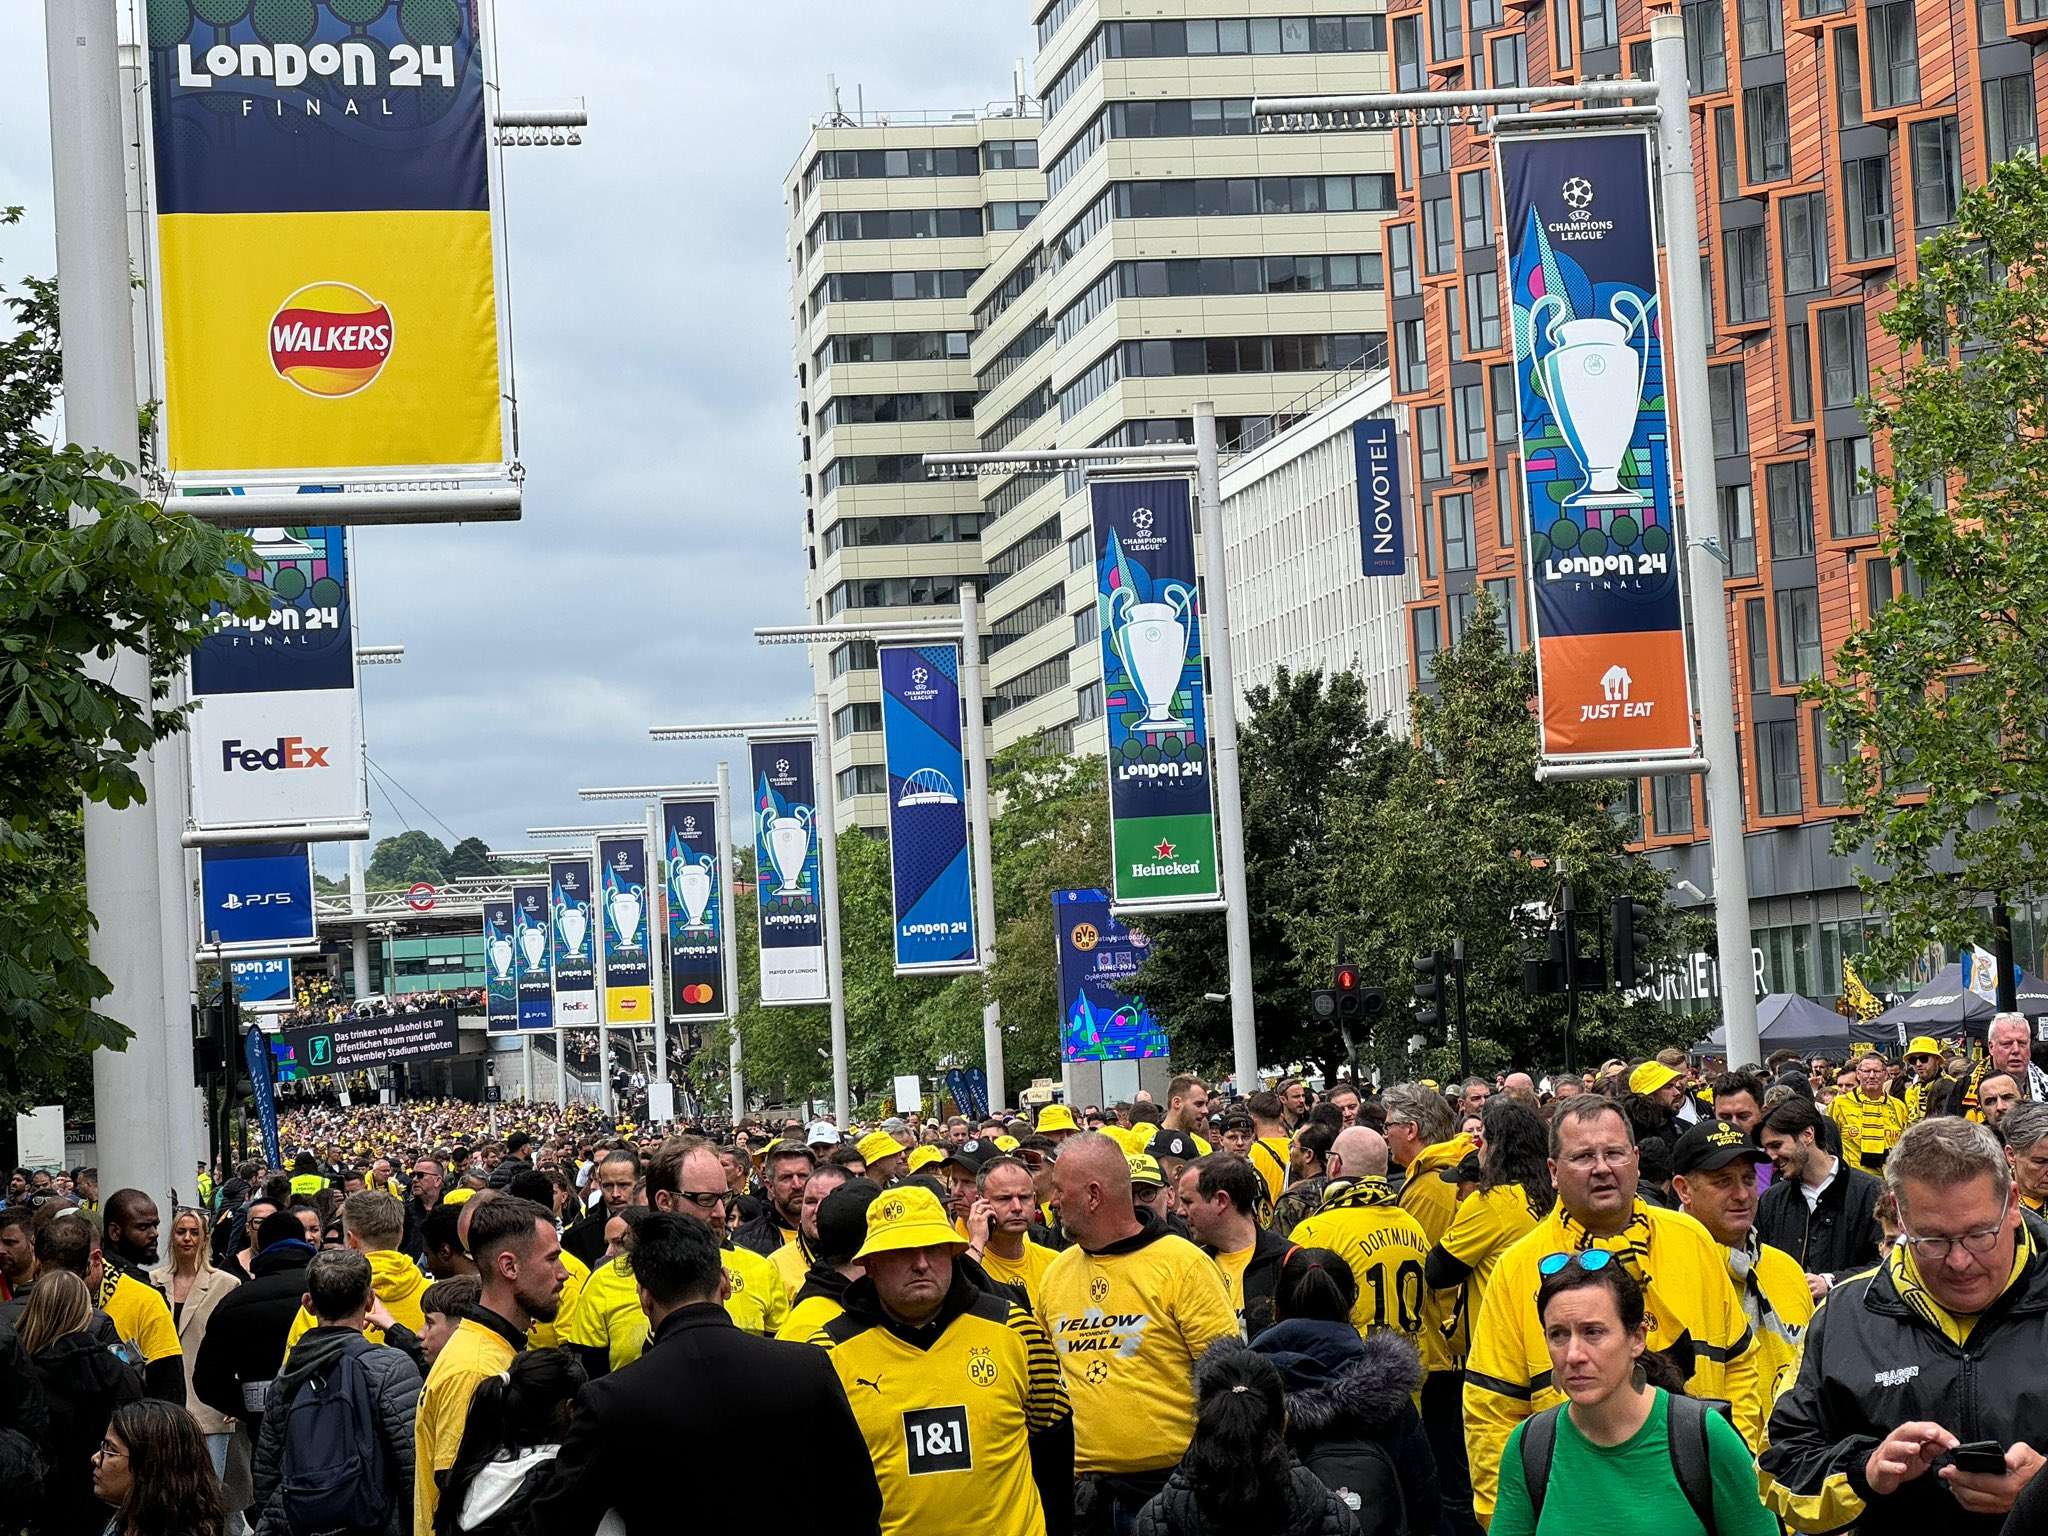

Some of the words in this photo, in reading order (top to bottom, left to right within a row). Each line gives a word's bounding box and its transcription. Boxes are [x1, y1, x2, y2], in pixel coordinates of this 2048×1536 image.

[389, 44, 455, 88] 24
[242, 98, 393, 116] FINAL
[1568, 209, 1592, 221] UEFA
[1548, 220, 1613, 232] CHAMPIONS
[1561, 231, 1603, 241] LEAGUE
[273, 321, 390, 353] WALKERS
[1367, 428, 1394, 554] NOVOTEL
[1122, 537, 1167, 545] CHAMPIONS
[1638, 553, 1667, 574] 24
[1575, 581, 1642, 592] FINAL
[305, 606, 338, 630] 24
[233, 636, 309, 647] FINAL
[903, 689, 939, 697] CHAMPIONS
[1580, 704, 1620, 722] JUST
[1623, 702, 1654, 718] EAT
[222, 736, 330, 772] FedEx
[1182, 761, 1202, 777] 24
[1138, 780, 1185, 788] FINAL
[1131, 861, 1200, 878] Heineken
[245, 892, 291, 906] PS5
[803, 913, 817, 924] 24
[951, 921, 967, 934] 24
[1075, 925, 1096, 943] BVB
[706, 945, 718, 954] 24
[265, 960, 283, 973] 24
[636, 962, 647, 970] 24
[562, 1001, 589, 1012] FedEx
[334, 1032, 349, 1041] Das
[350, 1029, 377, 1039] trinken
[378, 1026, 393, 1035] von
[394, 1021, 422, 1033] Alkohol
[423, 1019, 432, 1029] ist
[433, 1019, 443, 1027] im
[335, 1040, 382, 1053] öffentlichen
[383, 1036, 405, 1046] Raum
[405, 1032, 423, 1043] rund
[424, 1031, 437, 1040] um
[337, 1056, 351, 1065] das
[351, 1049, 387, 1063] Wembley
[387, 1044, 419, 1058] Stadium
[419, 1040, 453, 1052] verboten
[1706, 1131, 1744, 1143] YELLOW
[1359, 1227, 1425, 1258] DORTMUND
[1091, 1279, 1108, 1297] BVB
[1366, 1260, 1424, 1332] 10
[1058, 1314, 1144, 1333] YELLOW
[1079, 1330, 1111, 1338] WONDER
[1067, 1336, 1122, 1353] WALL
[971, 1358, 995, 1378] BVB
[1882, 1375, 1911, 1387] SPORT
[910, 1420, 962, 1457] 1&1
